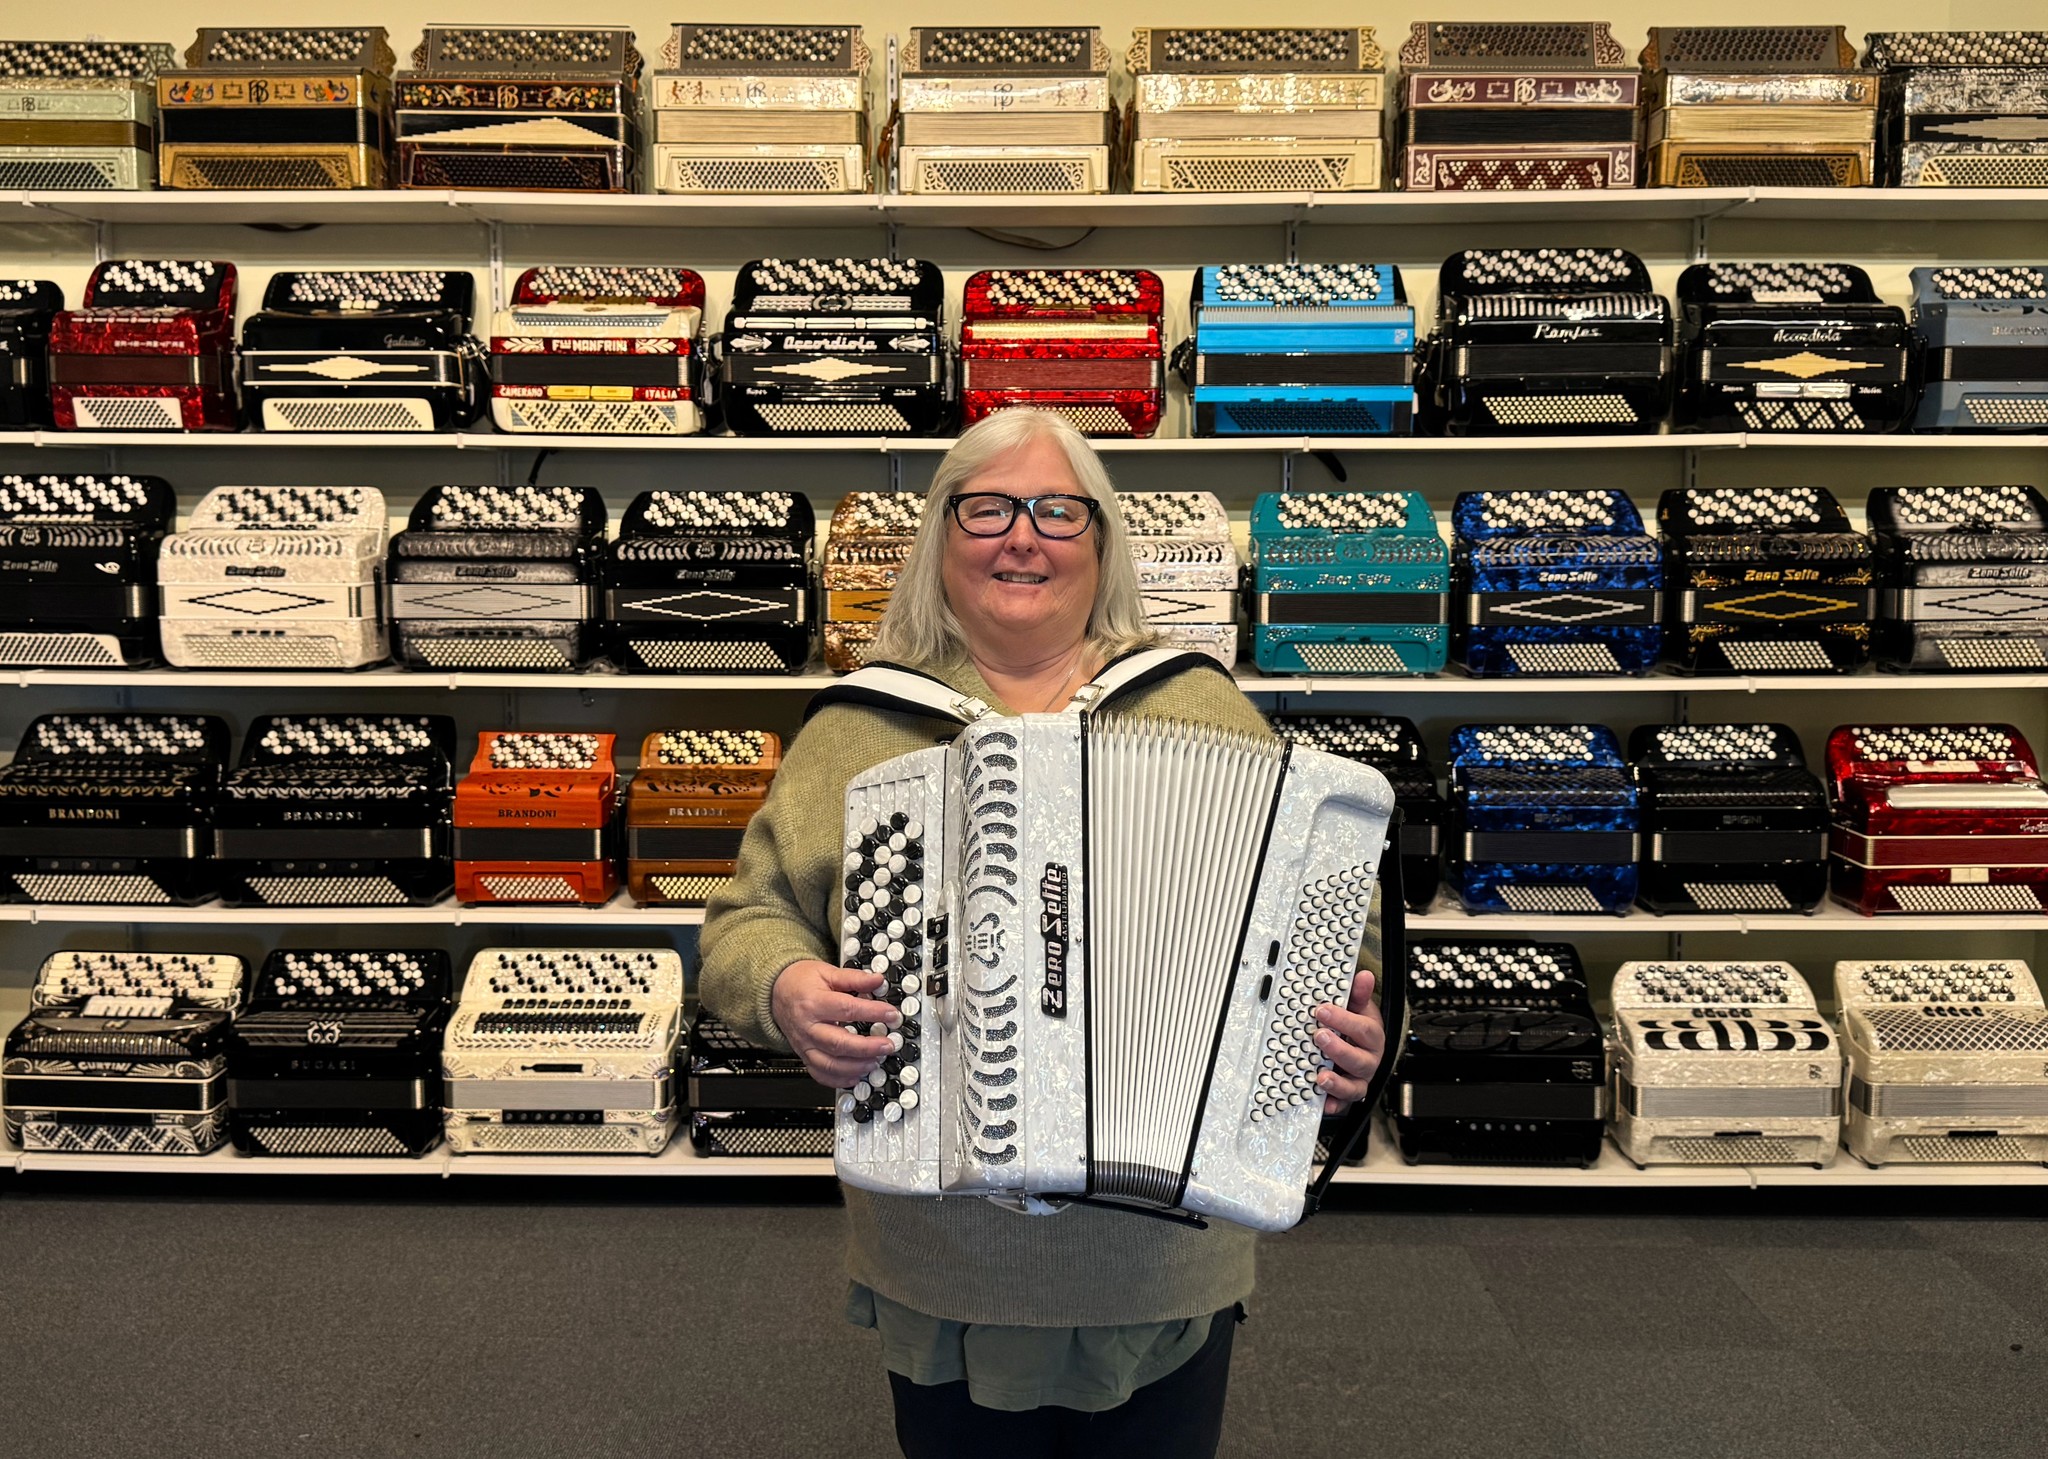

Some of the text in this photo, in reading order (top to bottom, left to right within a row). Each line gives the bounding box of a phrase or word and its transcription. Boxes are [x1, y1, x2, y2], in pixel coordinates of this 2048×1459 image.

[644, 390, 677, 400] ITALIA
[48, 808, 121, 819] BRANDONI
[283, 811, 362, 820] BRANDONI
[498, 809, 558, 818] BRANDONI
[1041, 868, 1063, 1008] Zero Sette
[78, 1061, 132, 1072] CURTINI
